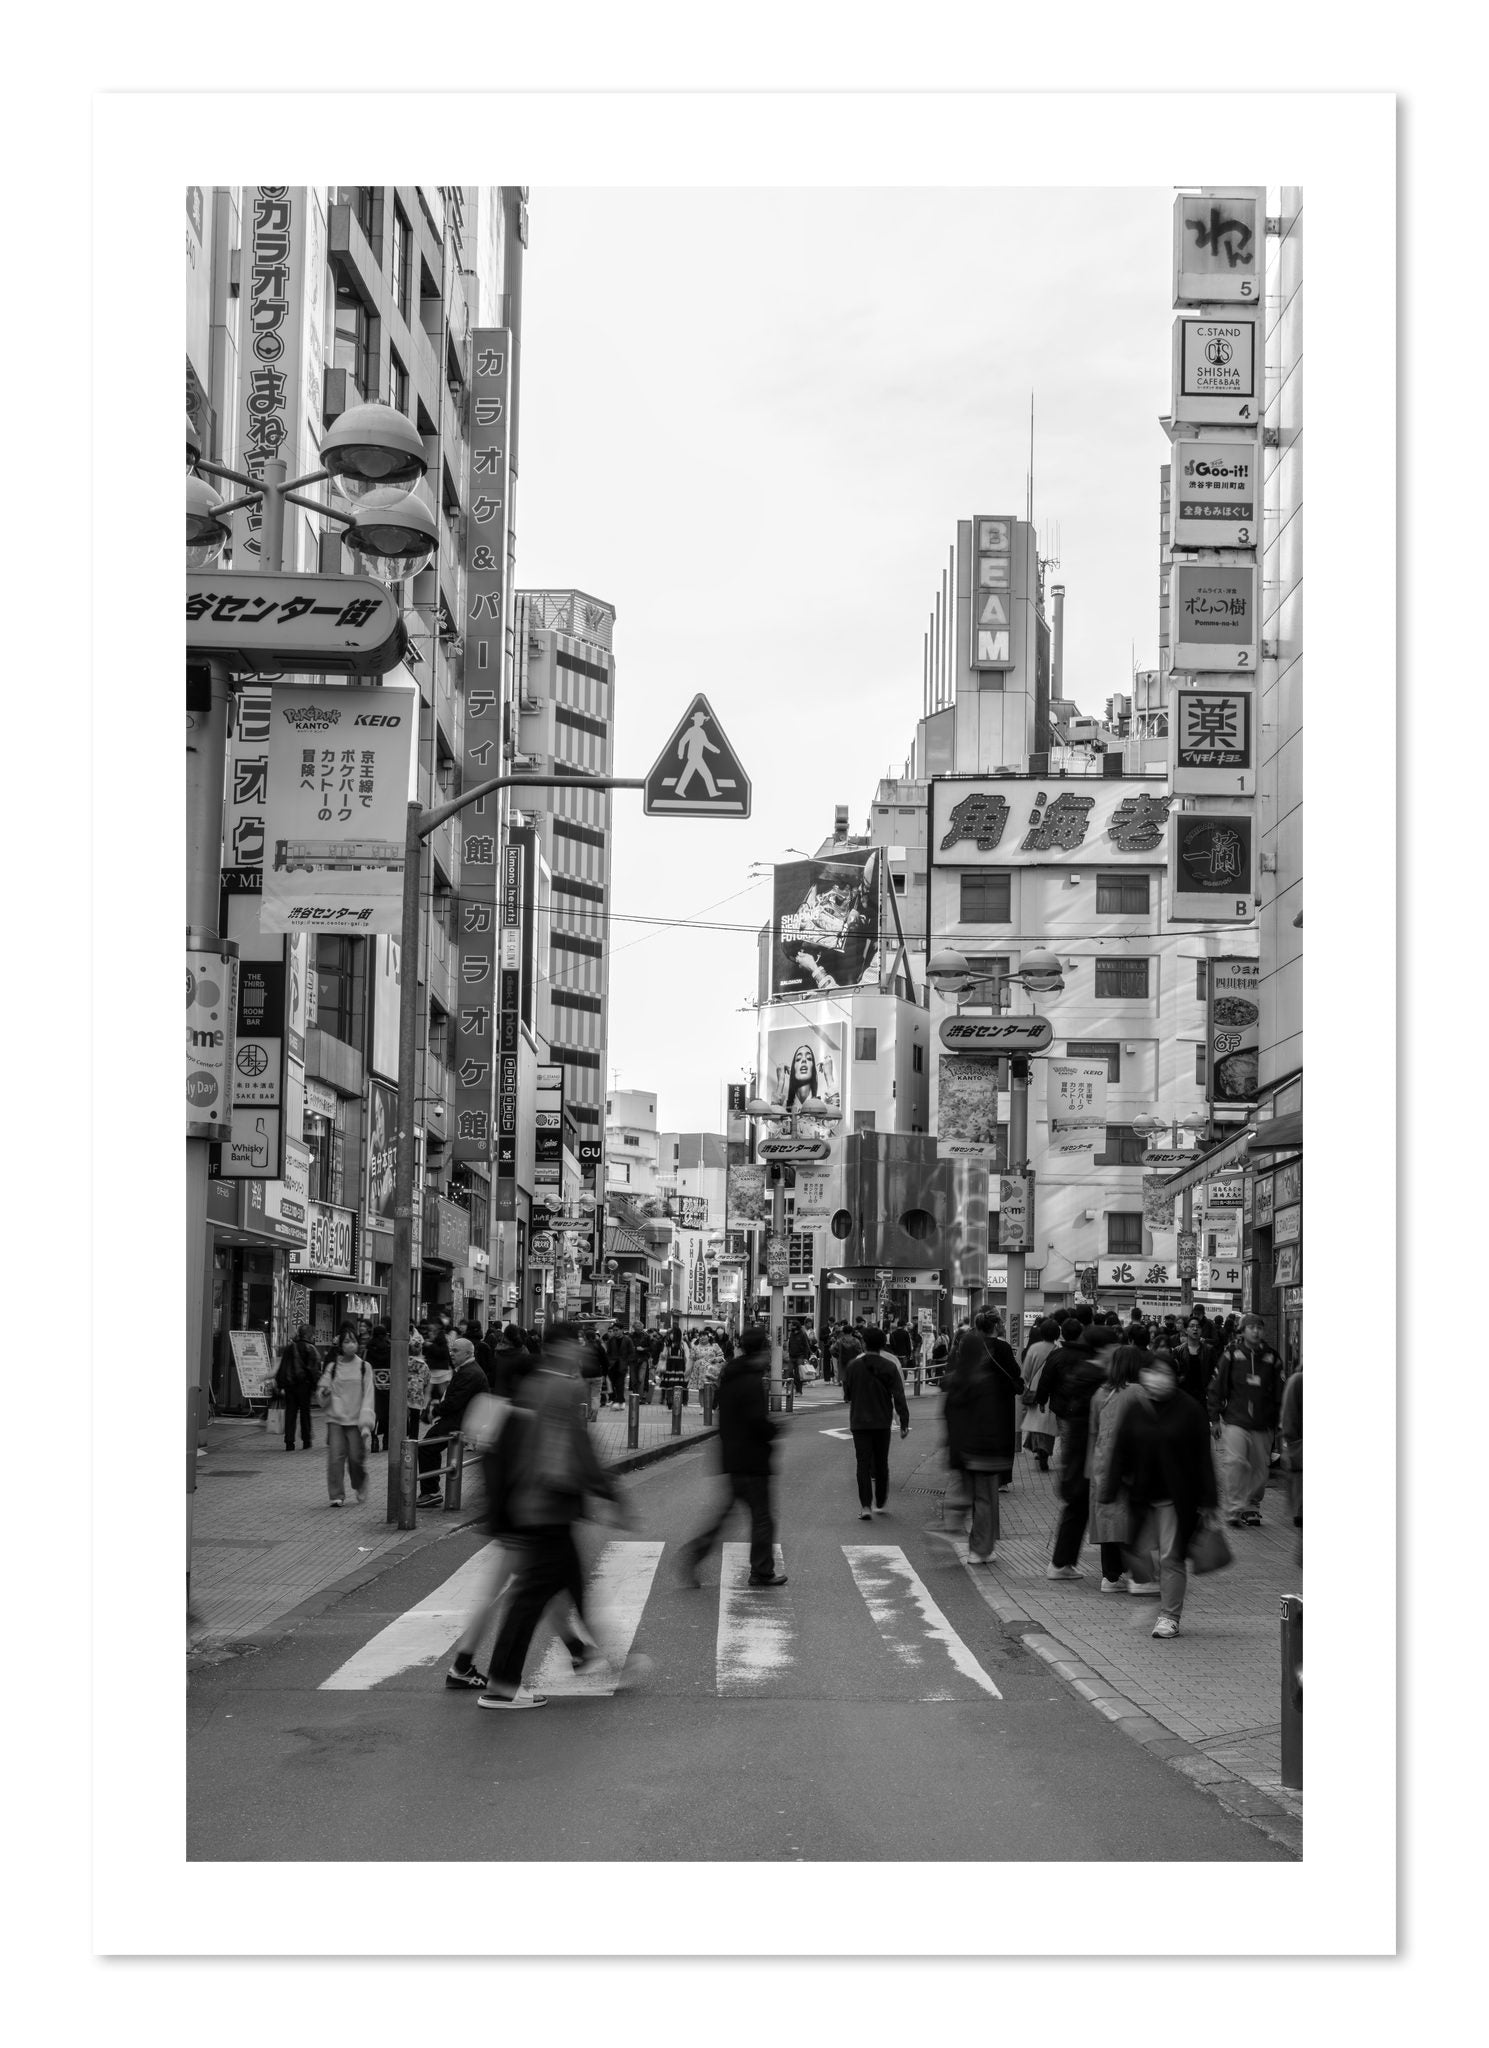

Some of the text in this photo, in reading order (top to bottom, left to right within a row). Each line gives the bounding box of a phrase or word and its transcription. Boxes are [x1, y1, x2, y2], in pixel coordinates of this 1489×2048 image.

[252, 199, 291, 332] カラオケ
[1240, 281, 1252, 296] 5
[1197, 327, 1241, 337] C.STAND
[1197, 367, 1240, 377] SHISHA
[1197, 378, 1240, 386] CAFE&BAR
[1239, 404, 1251, 419] 4
[1195, 462, 1248, 477] Goo-it!
[1189, 481, 1245, 490] 渋谷宇田川町店
[1184, 505, 1250, 517] 全身もみほぐし
[1238, 528, 1249, 544] 3
[978, 521, 1010, 661] BEAM
[1237, 651, 1248, 666] 2
[353, 714, 401, 728] KEIO
[1188, 698, 1237, 748] 薬
[300, 749, 316, 790] 冒険へ
[318, 749, 335, 821] カントーの
[359, 750, 375, 808] 京王線で
[1237, 776, 1245, 791] 1
[1182, 830, 1242, 877] 一蘭
[507, 850, 516, 922] kimono hearts
[287, 907, 374, 920] 渋谷センター街
[1236, 901, 1247, 916] B
[1216, 978, 1258, 990] 四川料理
[946, 1024, 1046, 1037] 渋谷センター街
[1213, 1033, 1242, 1052] 6F
[197, 1080, 217, 1095] Day!
[232, 1144, 264, 1155] Whisky
[581, 1147, 600, 1158] GU
[761, 1144, 822, 1152] 渋谷センター街
[231, 1152, 250, 1161] Bank
[1111, 1262, 1169, 1284] 兆楽
[696, 1262, 705, 1302] BEER
